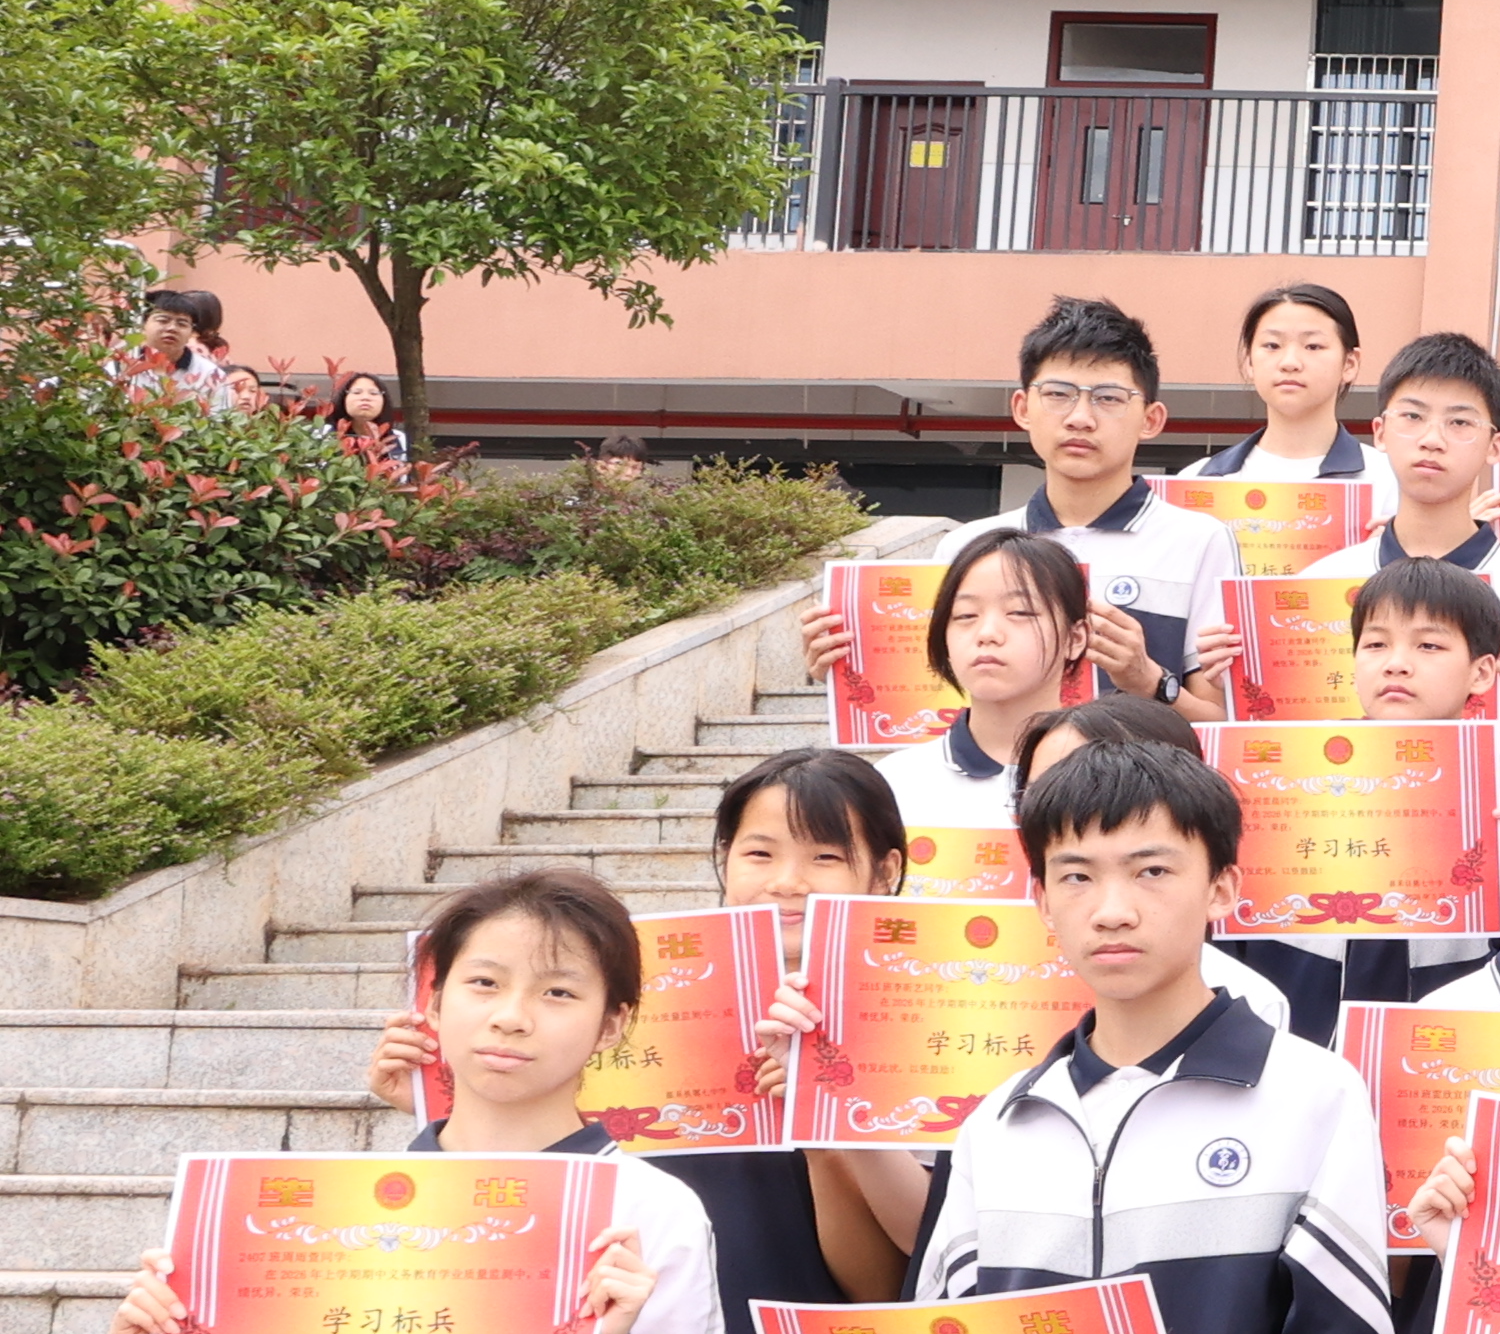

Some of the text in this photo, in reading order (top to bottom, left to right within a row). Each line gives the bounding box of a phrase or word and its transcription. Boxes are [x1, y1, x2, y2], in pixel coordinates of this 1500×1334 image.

[1396, 740, 1434, 761] 状
[1296, 837, 1391, 859] 学习标兵
[658, 933, 702, 959] 状
[928, 1031, 1035, 1057] 学习标兵
[474, 1178, 528, 1208] 状
[323, 1306, 455, 1334] 学习标兵
